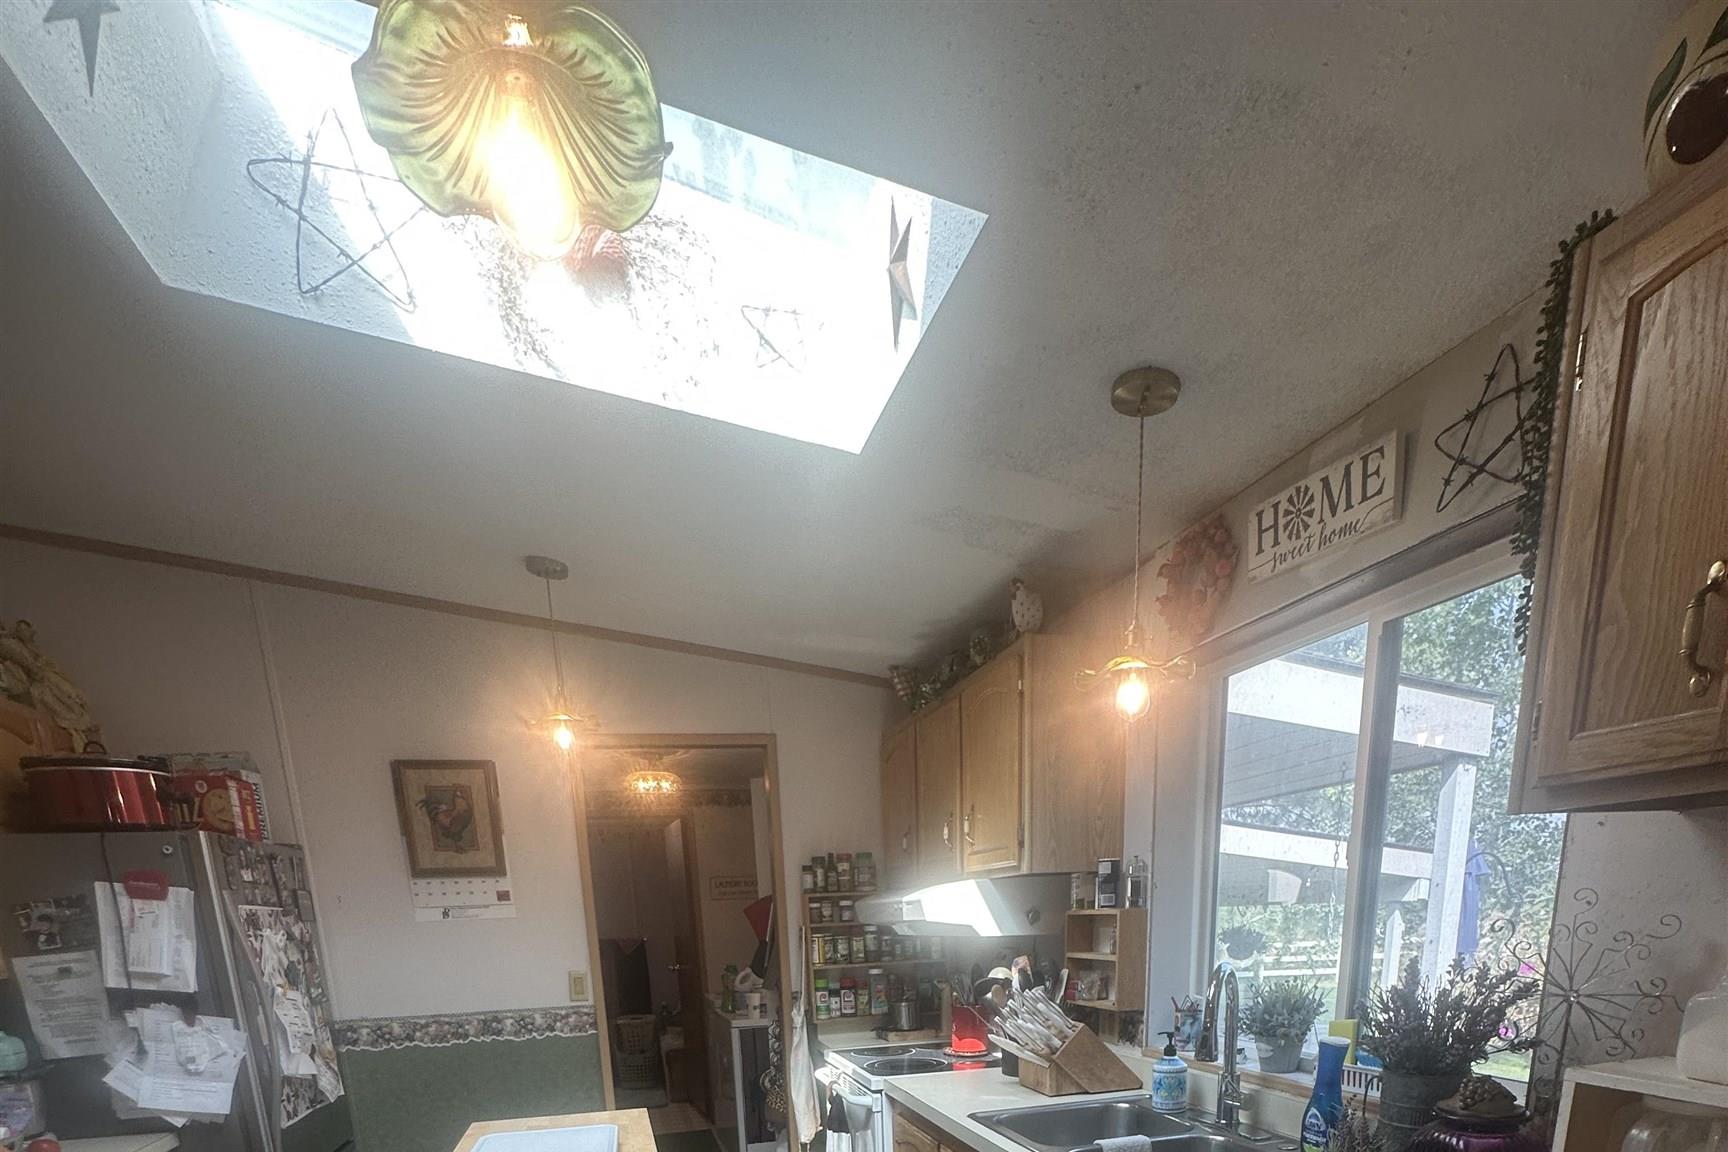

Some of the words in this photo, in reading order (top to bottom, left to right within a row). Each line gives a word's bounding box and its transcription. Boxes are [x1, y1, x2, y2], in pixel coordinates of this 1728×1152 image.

[1255, 445, 1386, 556] HOME
[1271, 533, 1315, 573] sweet
[1317, 516, 1366, 551] home
[252, 782, 271, 841] PREMIUM
